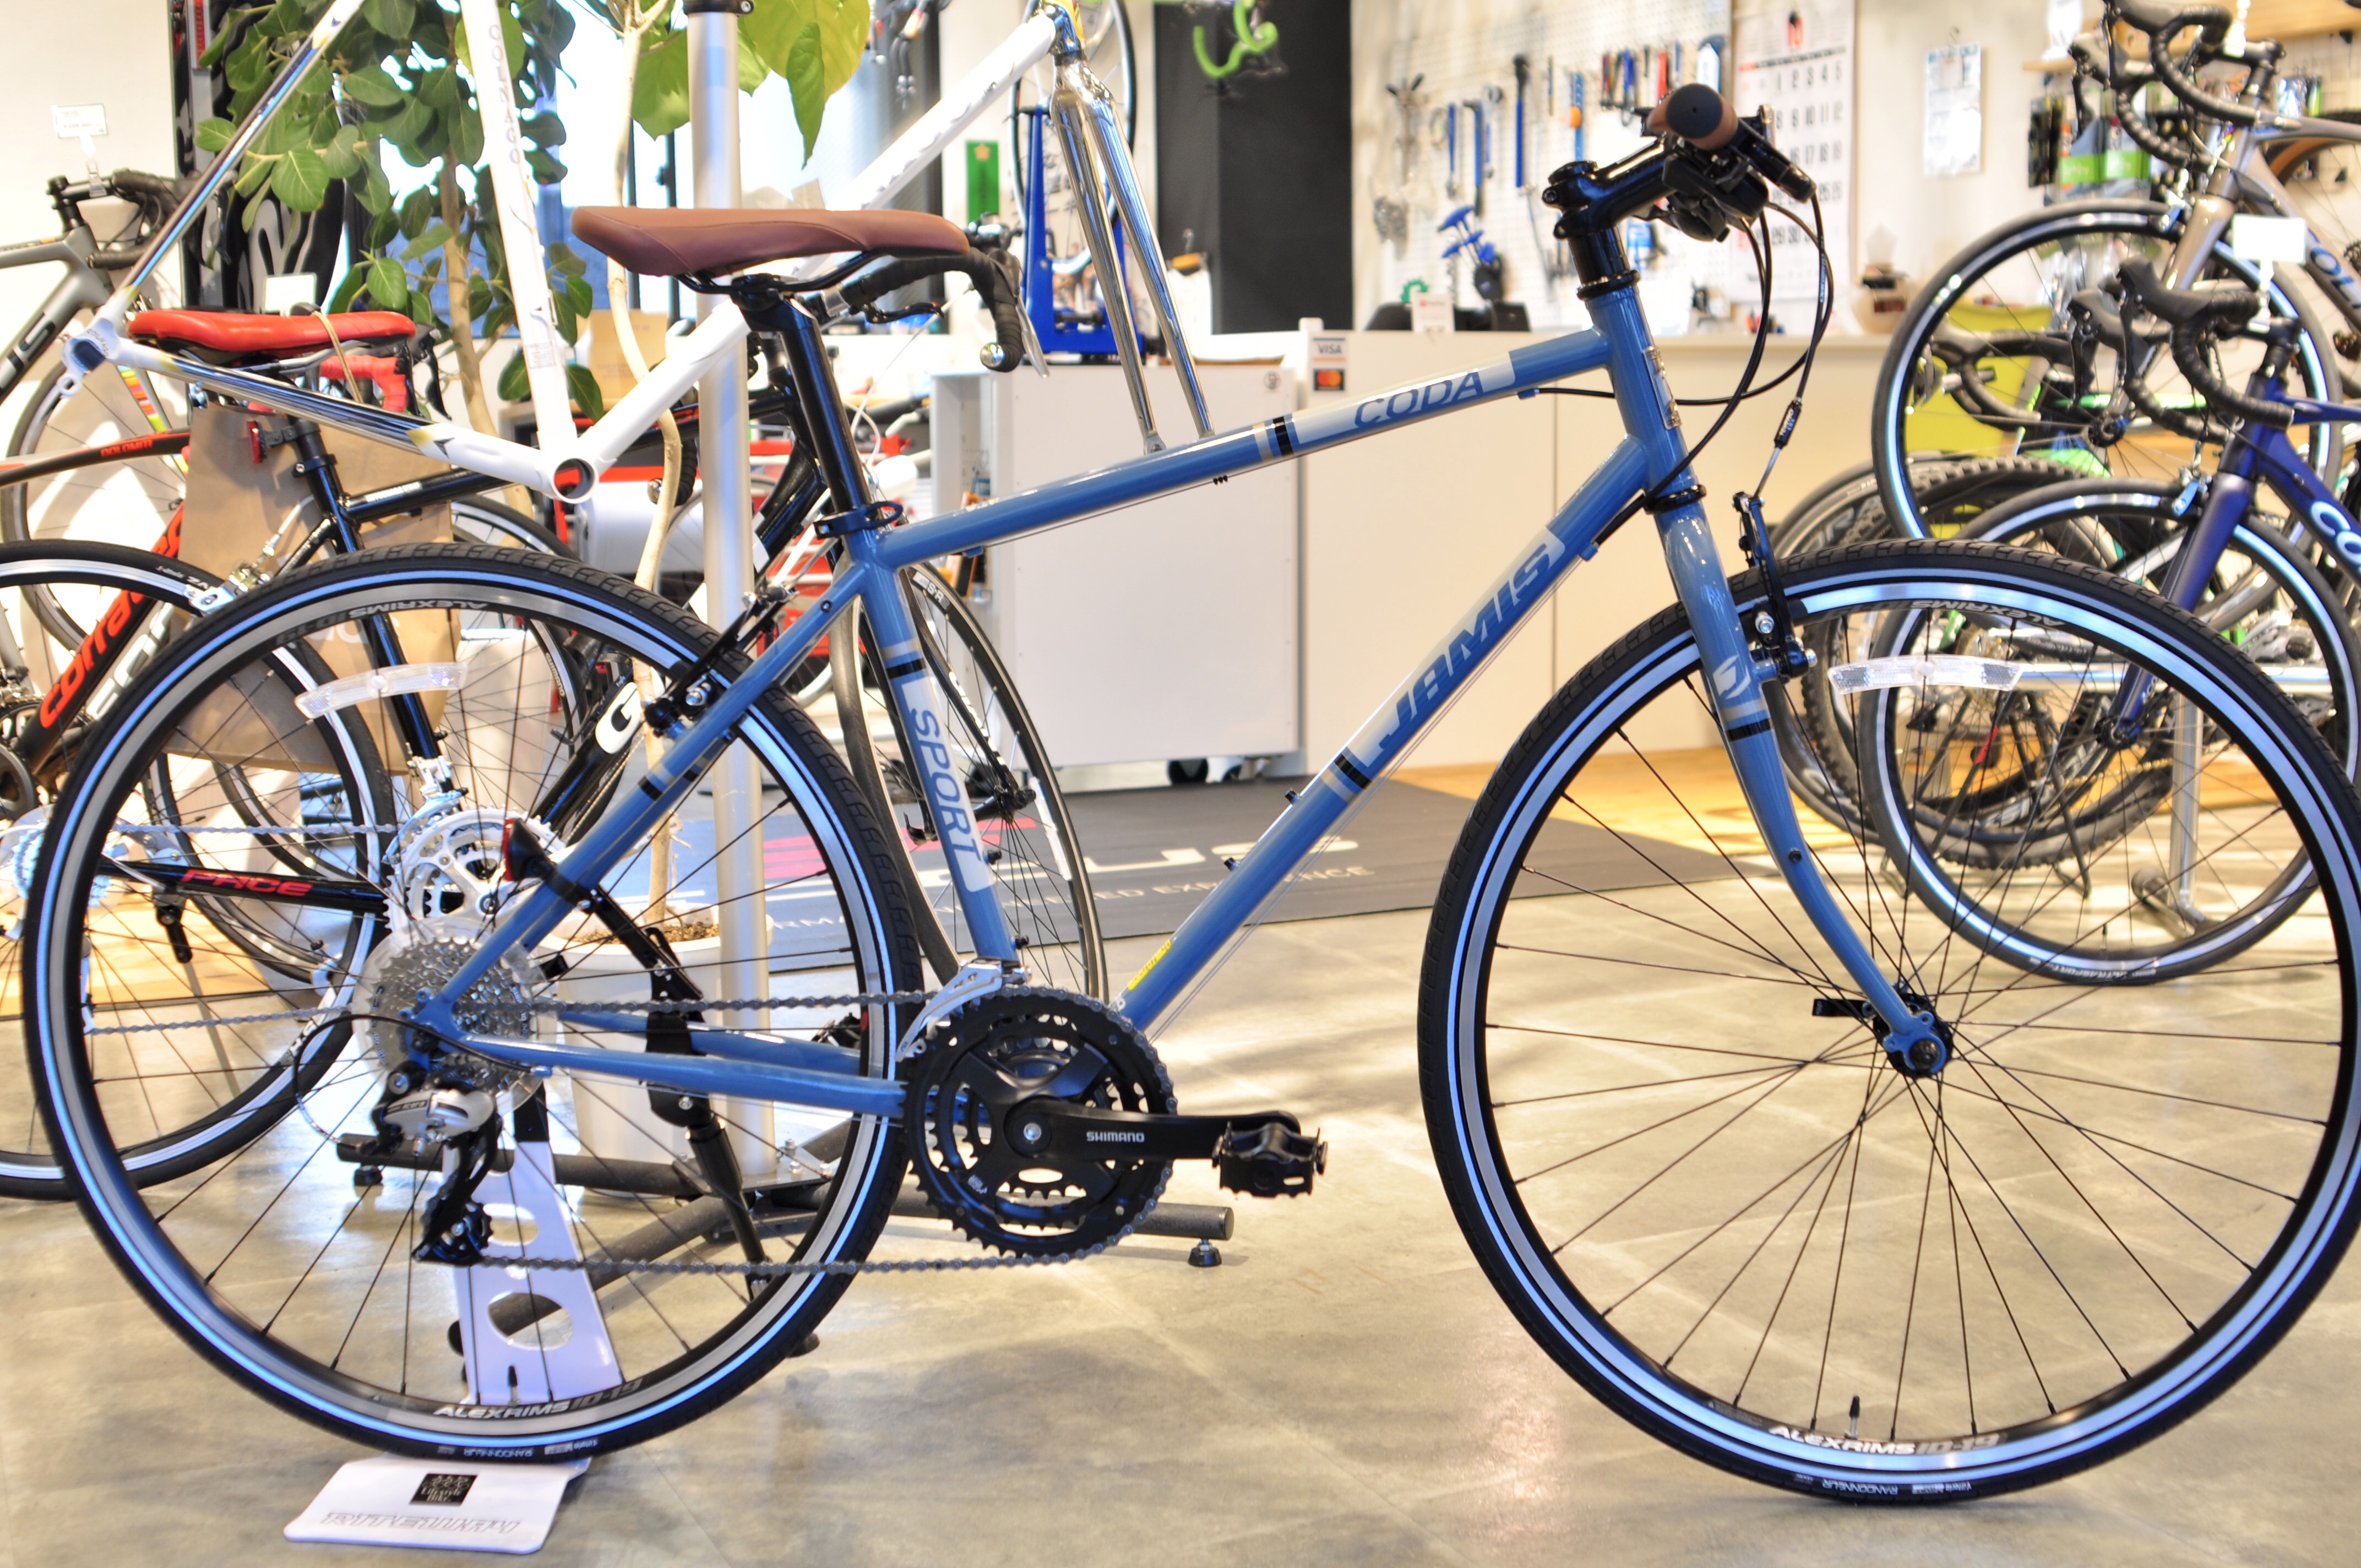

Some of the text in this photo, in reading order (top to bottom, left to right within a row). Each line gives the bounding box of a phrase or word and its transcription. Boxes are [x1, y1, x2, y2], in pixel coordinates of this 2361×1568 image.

[488, 24, 521, 164] COLNAGO
[1318, 344, 1342, 353] VISA
[1354, 371, 1484, 428] CODA
[348, 599, 489, 618] ALEXRIMS
[1911, 600, 2065, 626] ALEXRIMS
[1379, 543, 1551, 751] JAMIS
[545, 652, 566, 698] SHIMANO
[910, 708, 982, 862] SPORT
[181, 869, 313, 897] PACE
[1086, 1131, 1145, 1143] SHIMANO
[433, 1401, 570, 1419] ALEXRIMS
[463, 1447, 534, 1458] RANDONNEUR
[1768, 1425, 1915, 1455] ALEXRIMS
[1821, 1479, 1898, 1495] RANDONNEUR
